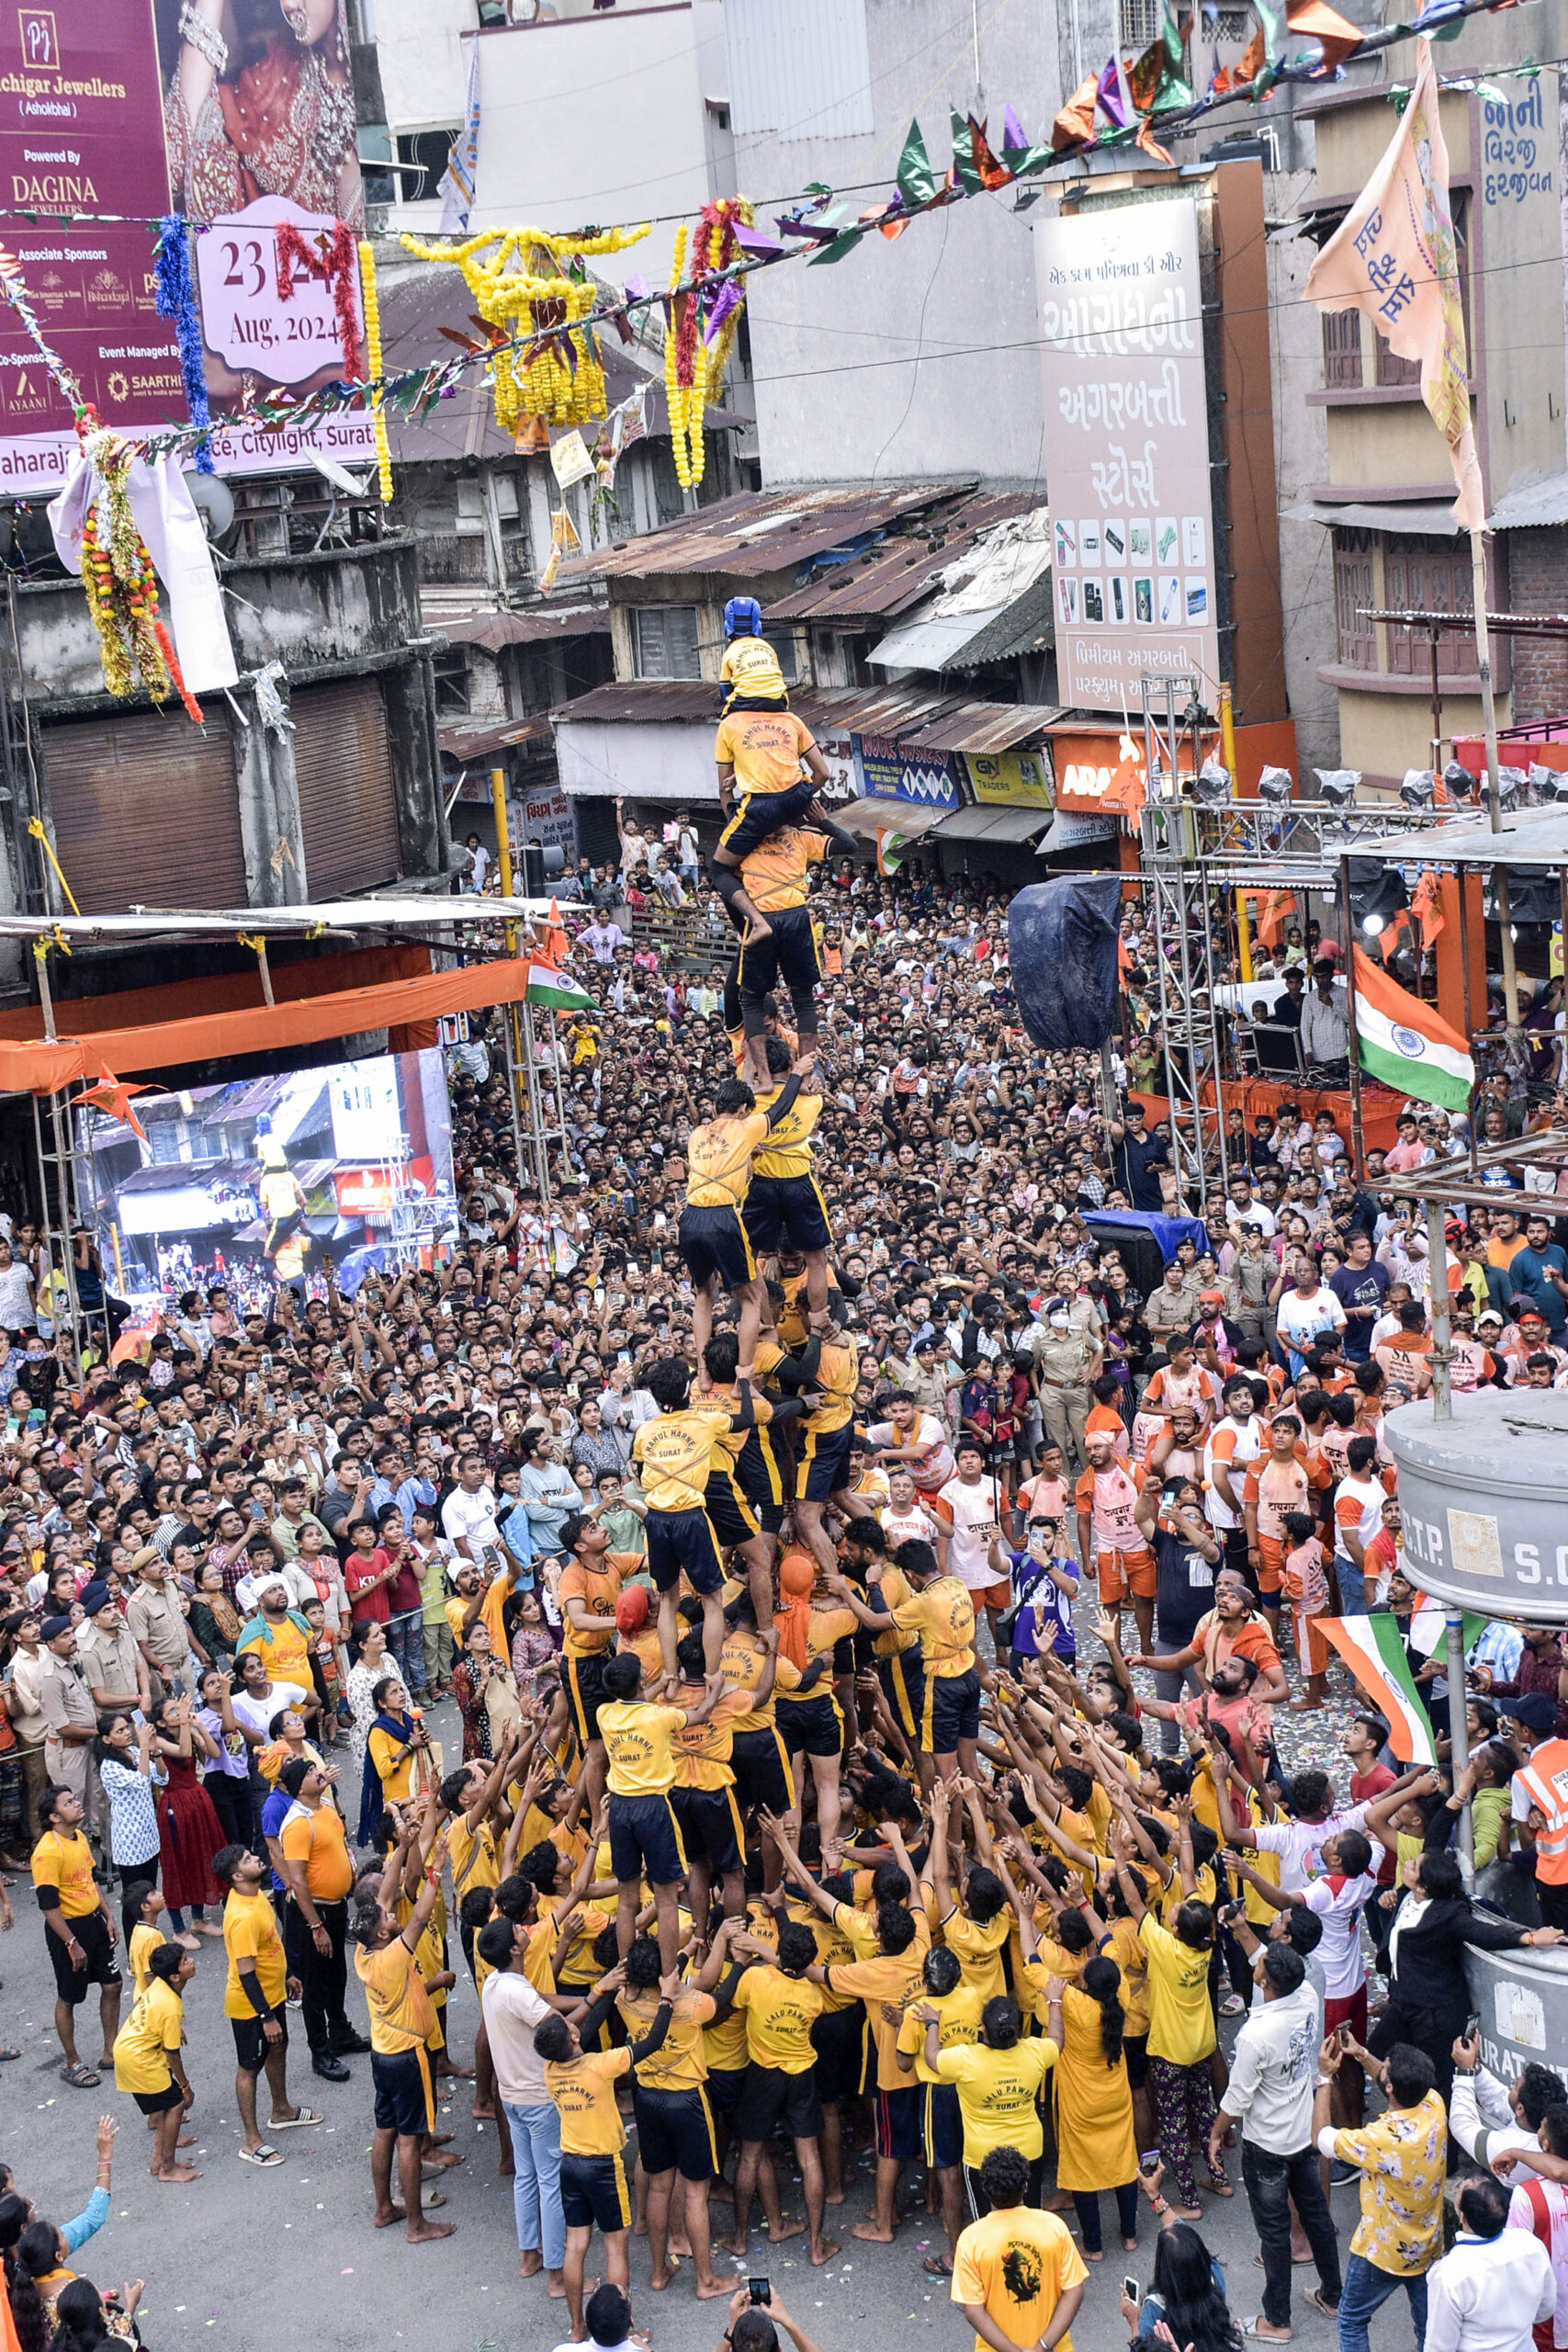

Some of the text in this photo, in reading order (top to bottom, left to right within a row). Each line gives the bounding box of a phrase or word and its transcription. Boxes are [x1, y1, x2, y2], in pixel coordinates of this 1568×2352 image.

[53, 75, 126, 98] Jewellers
[24, 150, 81, 165] Powered By
[12, 175, 99, 203] DAGINA
[18, 247, 107, 262] Associate Sponsors
[220, 241, 266, 297] 23
[1043, 287, 1194, 358] આરાધના
[231, 312, 339, 350] Aug, 2024
[98, 346, 126, 358] Event
[128, 345, 169, 359] Managed
[171, 345, 182, 360] By
[131, 374, 182, 389] SAARTHI
[1058, 358, 1187, 433] અગરબત્તી
[242, 425, 322, 459] Citylight,
[747, 659, 769, 669] SURAT
[742, 725, 761, 746] RAHUL
[757, 740, 779, 750] SURAT
[977, 780, 1010, 791] TRADERS
[771, 1127, 789, 1136] URAT
[646, 1430, 695, 1453] RAHUL HARNE
[659, 1449, 681, 1458] SURAT
[738, 1651, 753, 1674] HARNE
[627, 1734, 654, 1752] HARNE
[682, 1734, 704, 1742] SURAT
[618, 1753, 640, 1762] SURAT
[765, 2009, 784, 2025] LALU
[570, 2085, 595, 2102] HARNE
[982, 2089, 1002, 2105] LALU
